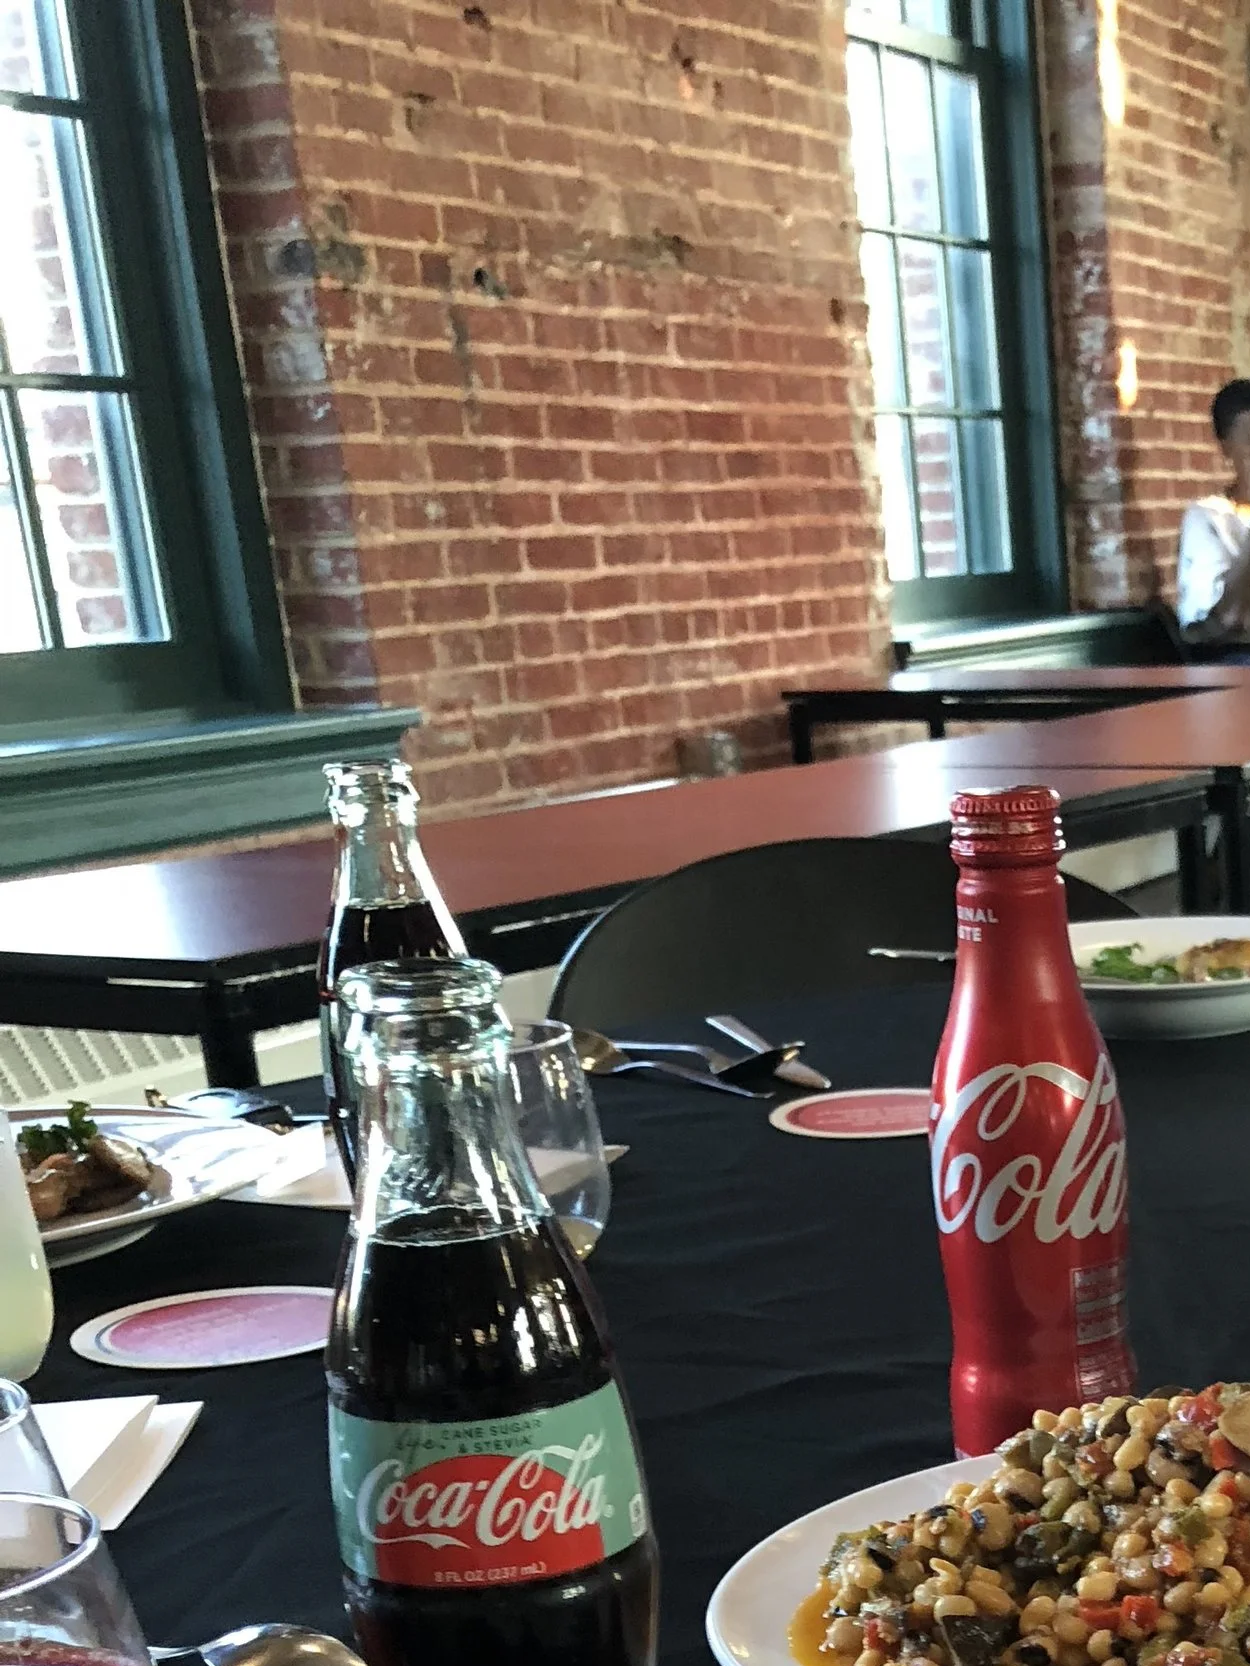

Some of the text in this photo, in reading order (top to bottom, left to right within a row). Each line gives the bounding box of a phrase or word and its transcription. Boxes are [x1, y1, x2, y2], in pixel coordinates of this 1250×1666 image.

[441, 1417, 543, 1441] CANE SUGAR
[474, 1434, 533, 1454] STEVIA
[356, 1433, 606, 1550] Coca-Cola
[463, 1568, 485, 1582] OZ
